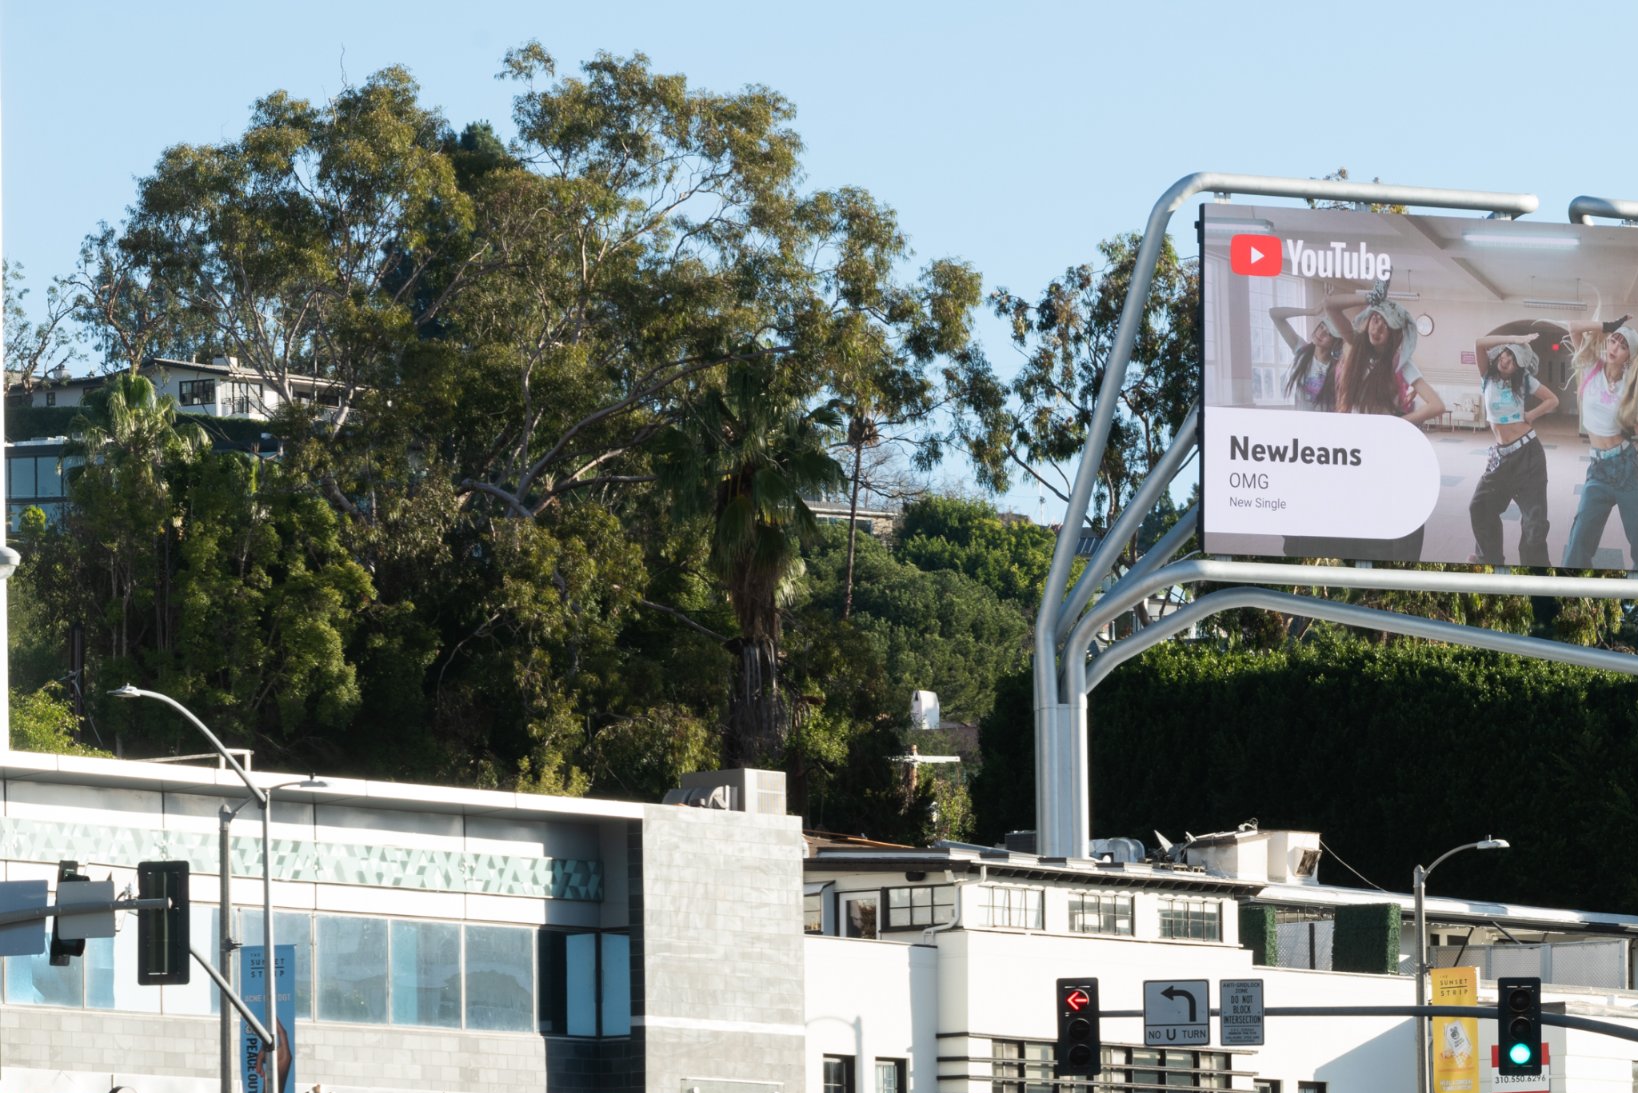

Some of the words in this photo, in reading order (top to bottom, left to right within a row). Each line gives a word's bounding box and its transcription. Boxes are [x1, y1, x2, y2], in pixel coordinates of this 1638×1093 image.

[1287, 239, 1391, 281] YouTube
[1230, 435, 1362, 467] NewJeans
[1229, 472, 1269, 489] OMG
[1229, 496, 1252, 508] New
[1255, 498, 1287, 511] Single
[250, 957, 285, 967] SUNET
[250, 970, 285, 978] STIP
[1440, 978, 1468, 986] SUNSET
[1440, 989, 1468, 997] STRIP
[1231, 994, 1239, 1004] DO
[1242, 994, 1253, 1004] NOT
[1233, 1005, 1251, 1014] BLOCK
[1223, 1015, 1261, 1024] INTERSECTION
[1148, 1030, 1161, 1040] NO
[1166, 1028, 1177, 1041] U
[1182, 1030, 1207, 1040] TURN
[246, 1037, 258, 1075] PEACE
